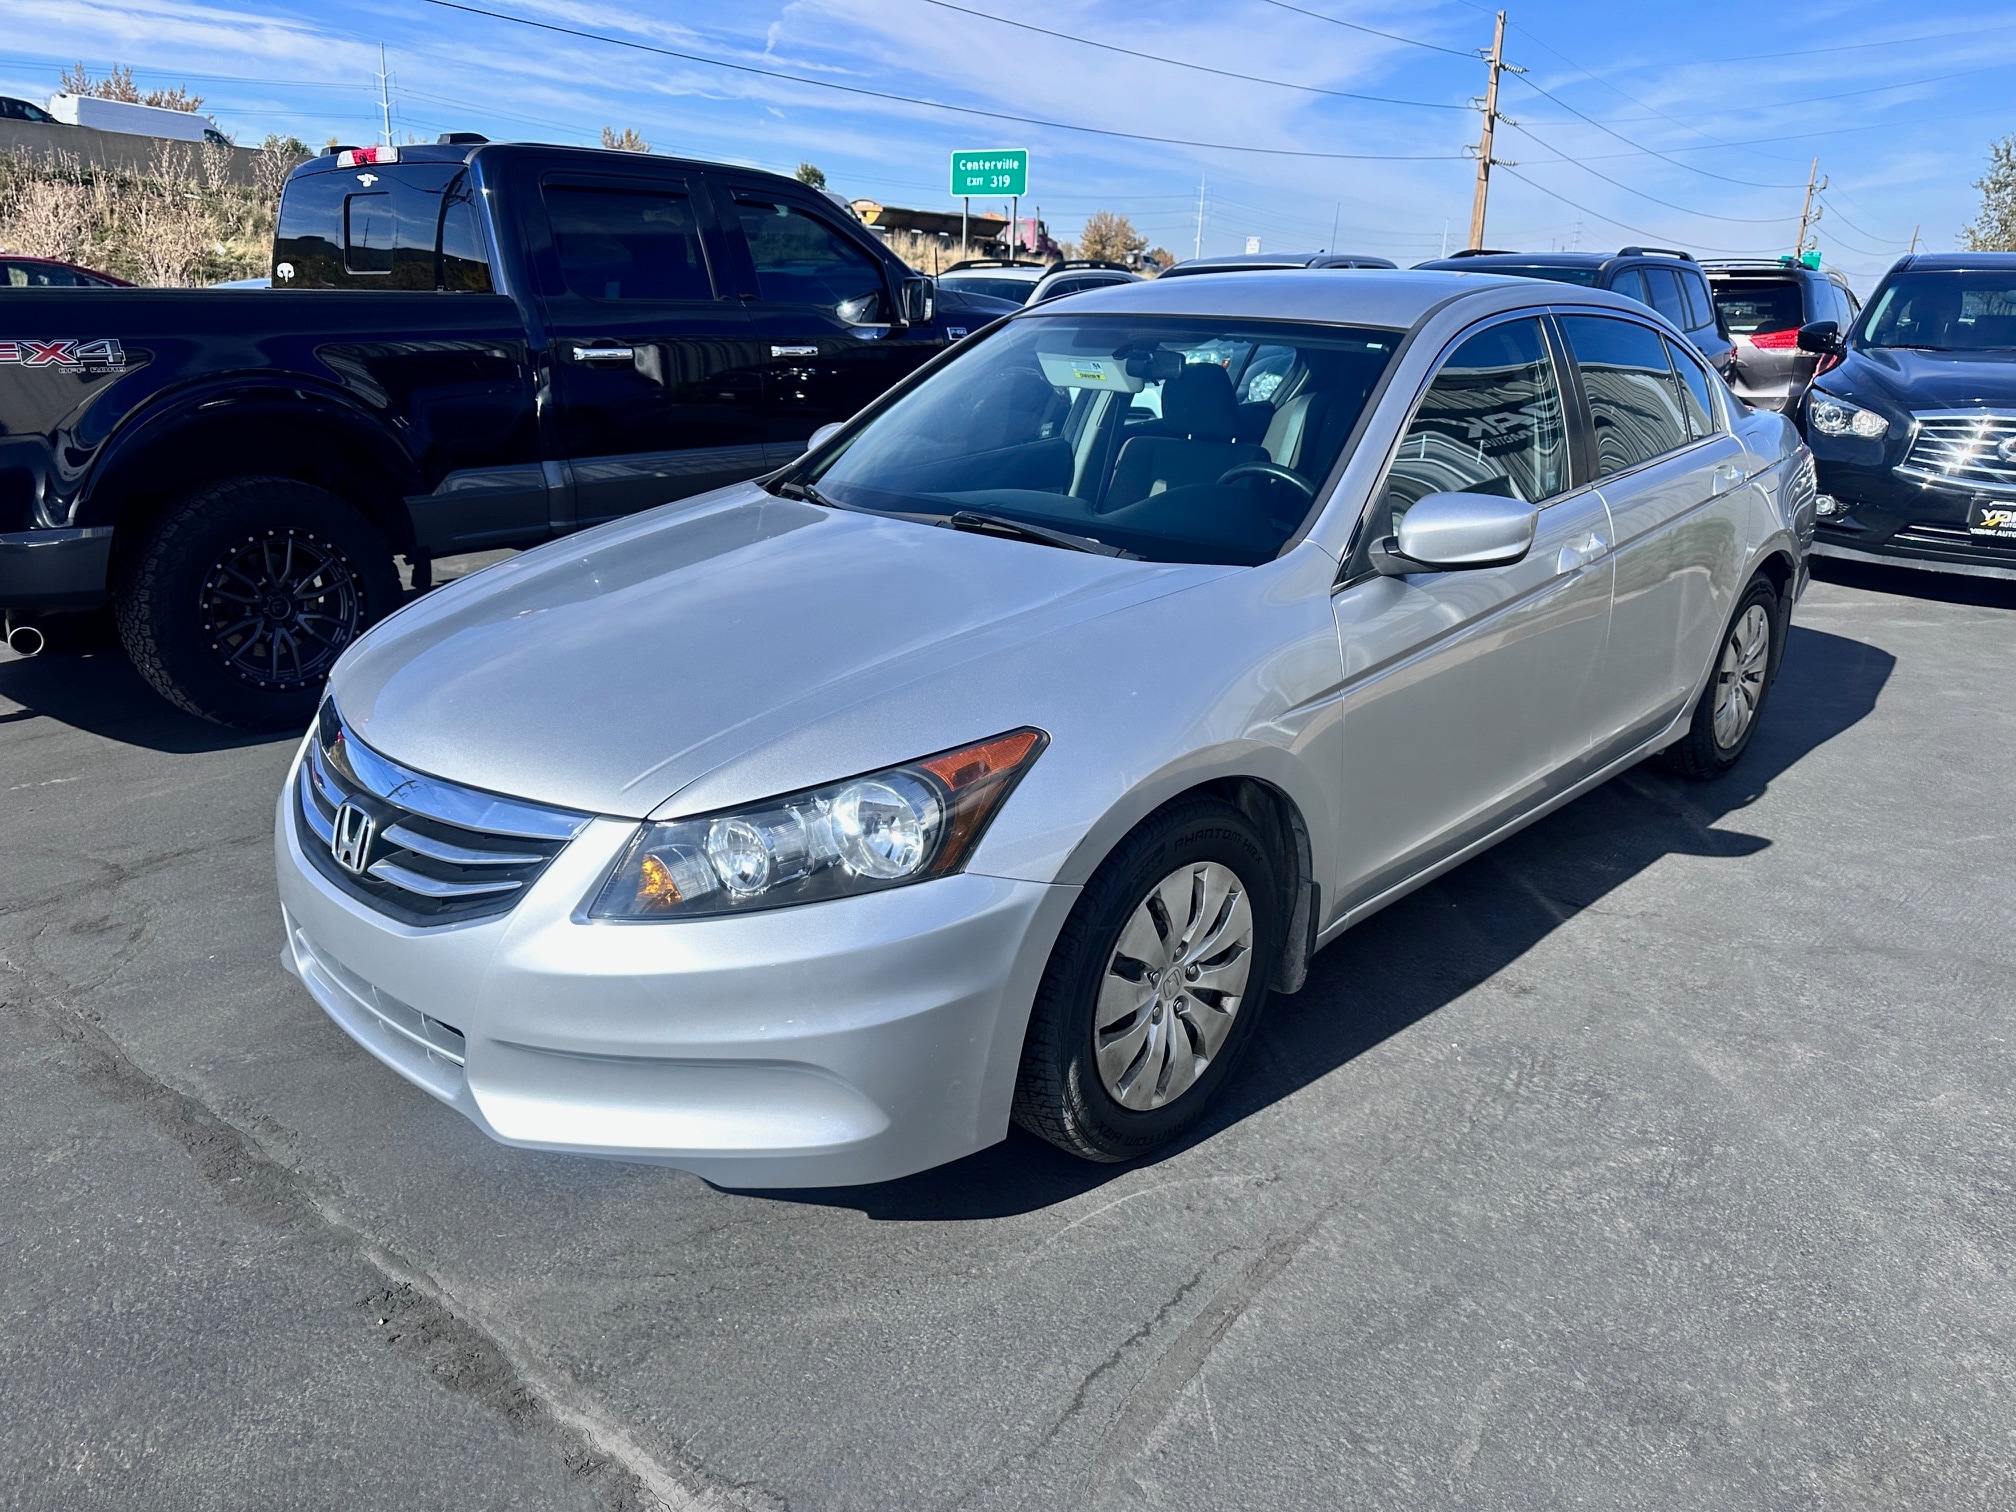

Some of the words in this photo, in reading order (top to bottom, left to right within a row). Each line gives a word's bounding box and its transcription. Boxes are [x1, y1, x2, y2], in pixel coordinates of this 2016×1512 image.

[959, 158, 1019, 171] Centerville
[966, 177, 984, 187] EXIT
[990, 174, 1011, 188] 319
[1174, 827, 1242, 853] PHANTOM
[1242, 838, 1263, 865] HRX
